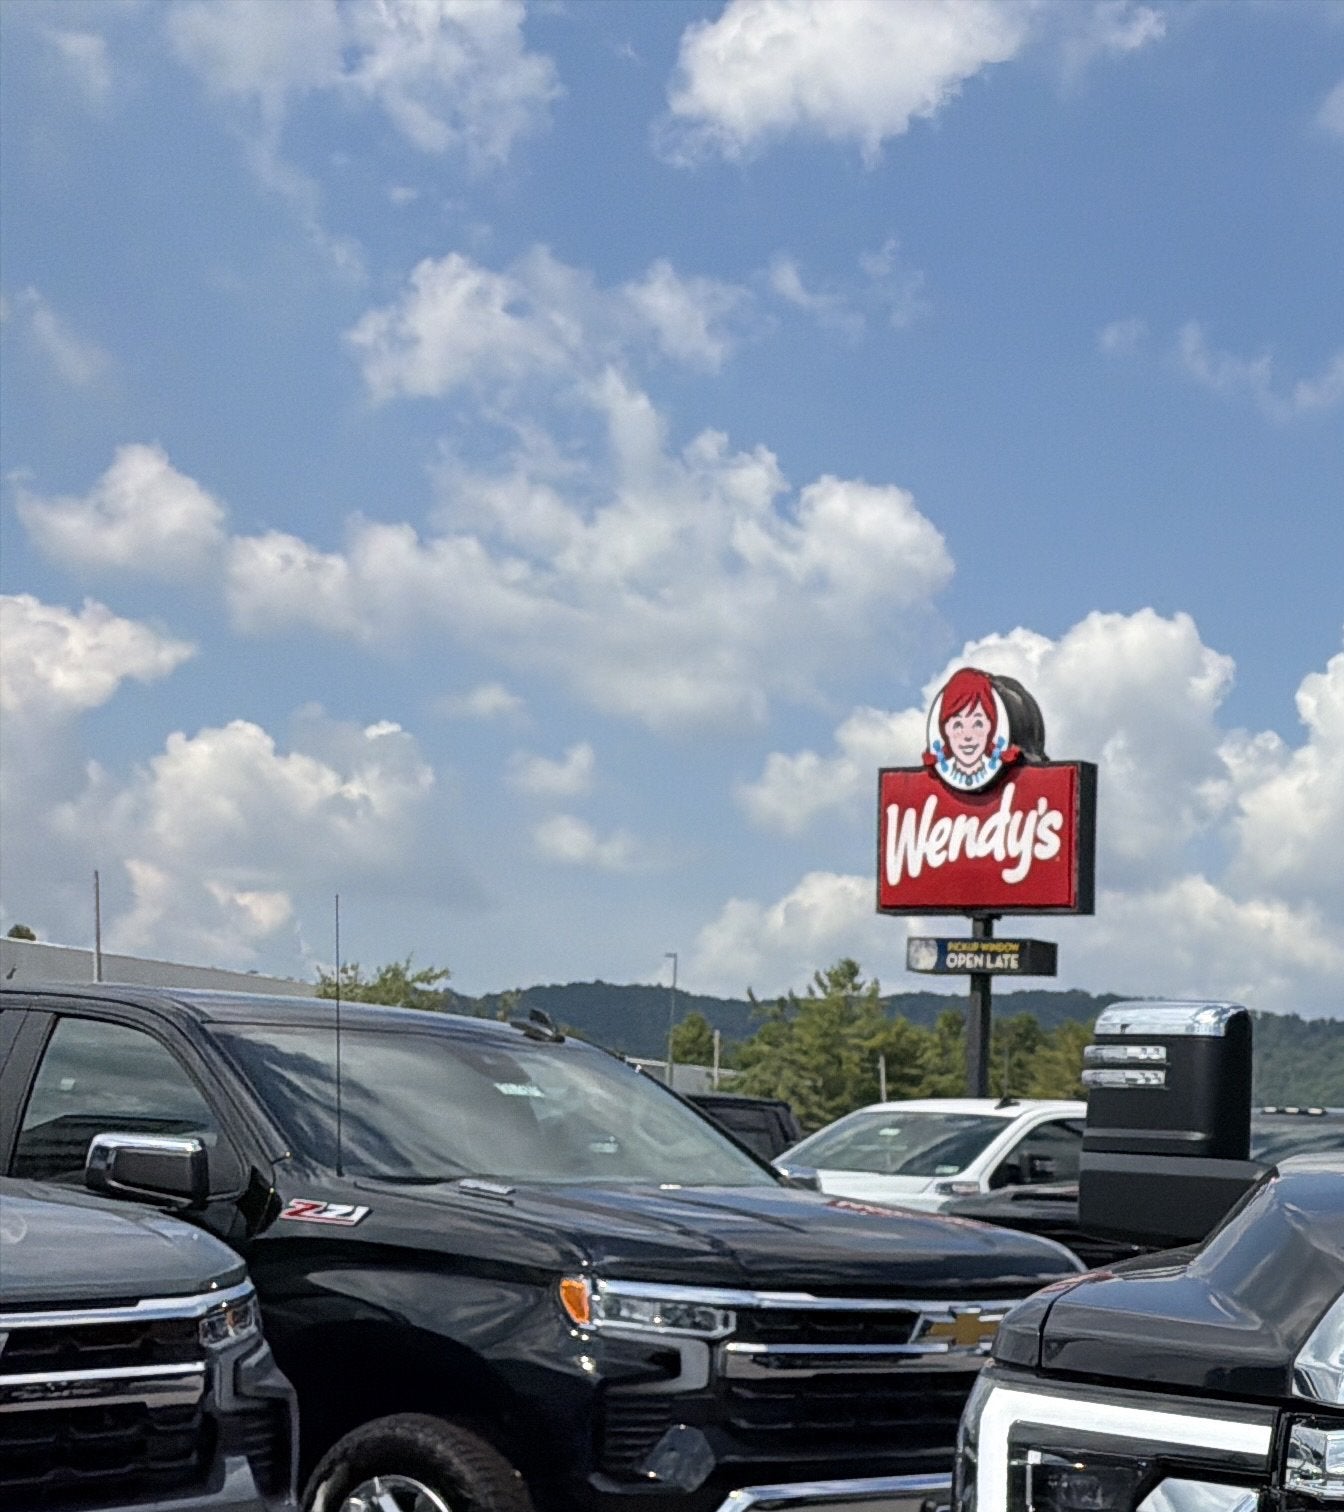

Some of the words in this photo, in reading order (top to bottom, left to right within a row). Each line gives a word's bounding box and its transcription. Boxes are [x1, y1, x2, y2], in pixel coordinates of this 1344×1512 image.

[886, 781, 1064, 887] Wendy's
[946, 952, 984, 969] OPEN
[986, 953, 1019, 969] LATE
[279, 1198, 370, 1227] Z71
